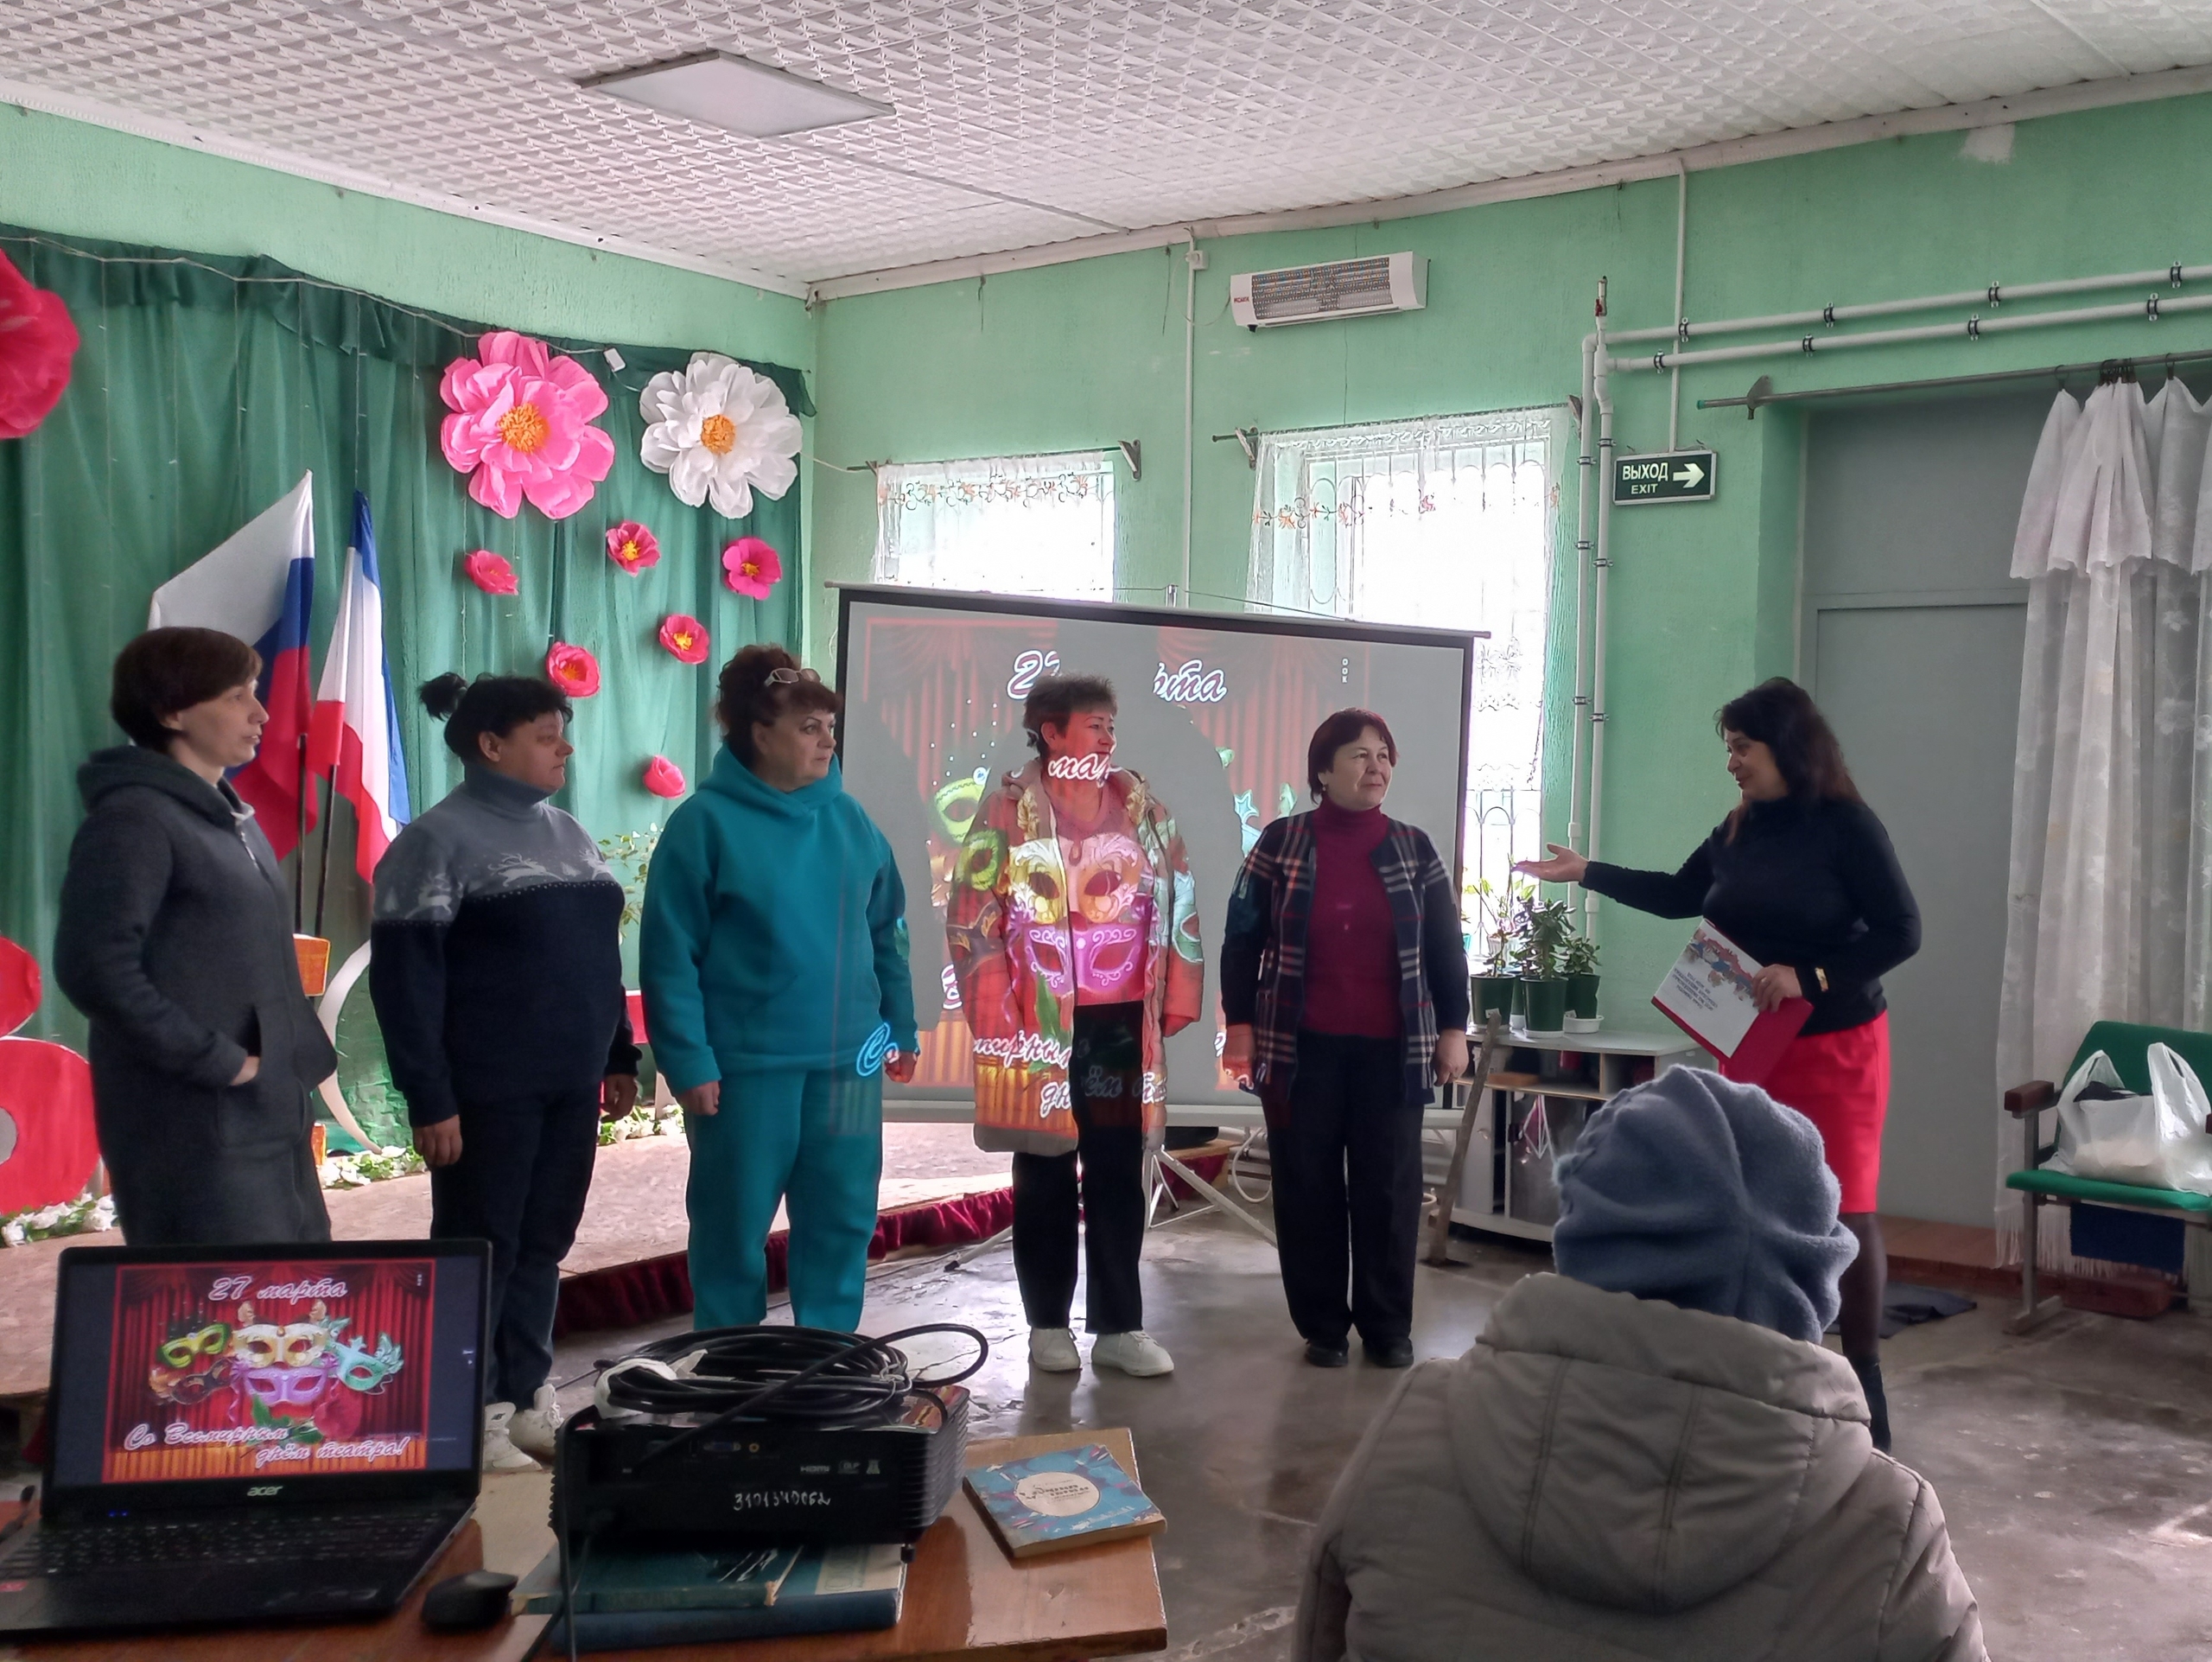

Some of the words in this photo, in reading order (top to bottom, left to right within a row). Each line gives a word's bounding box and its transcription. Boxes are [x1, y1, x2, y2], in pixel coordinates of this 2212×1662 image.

[1623, 462, 1669, 481] ВЫХОД
[1630, 483, 1658, 494] EXIT
[208, 1276, 252, 1301] 27
[257, 1277, 348, 1305] марта
[124, 1423, 156, 1450] Со
[163, 1423, 289, 1447] Всемирным
[256, 1443, 310, 1468] днём
[315, 1436, 411, 1462] театра!
[246, 1484, 283, 1497] acer
